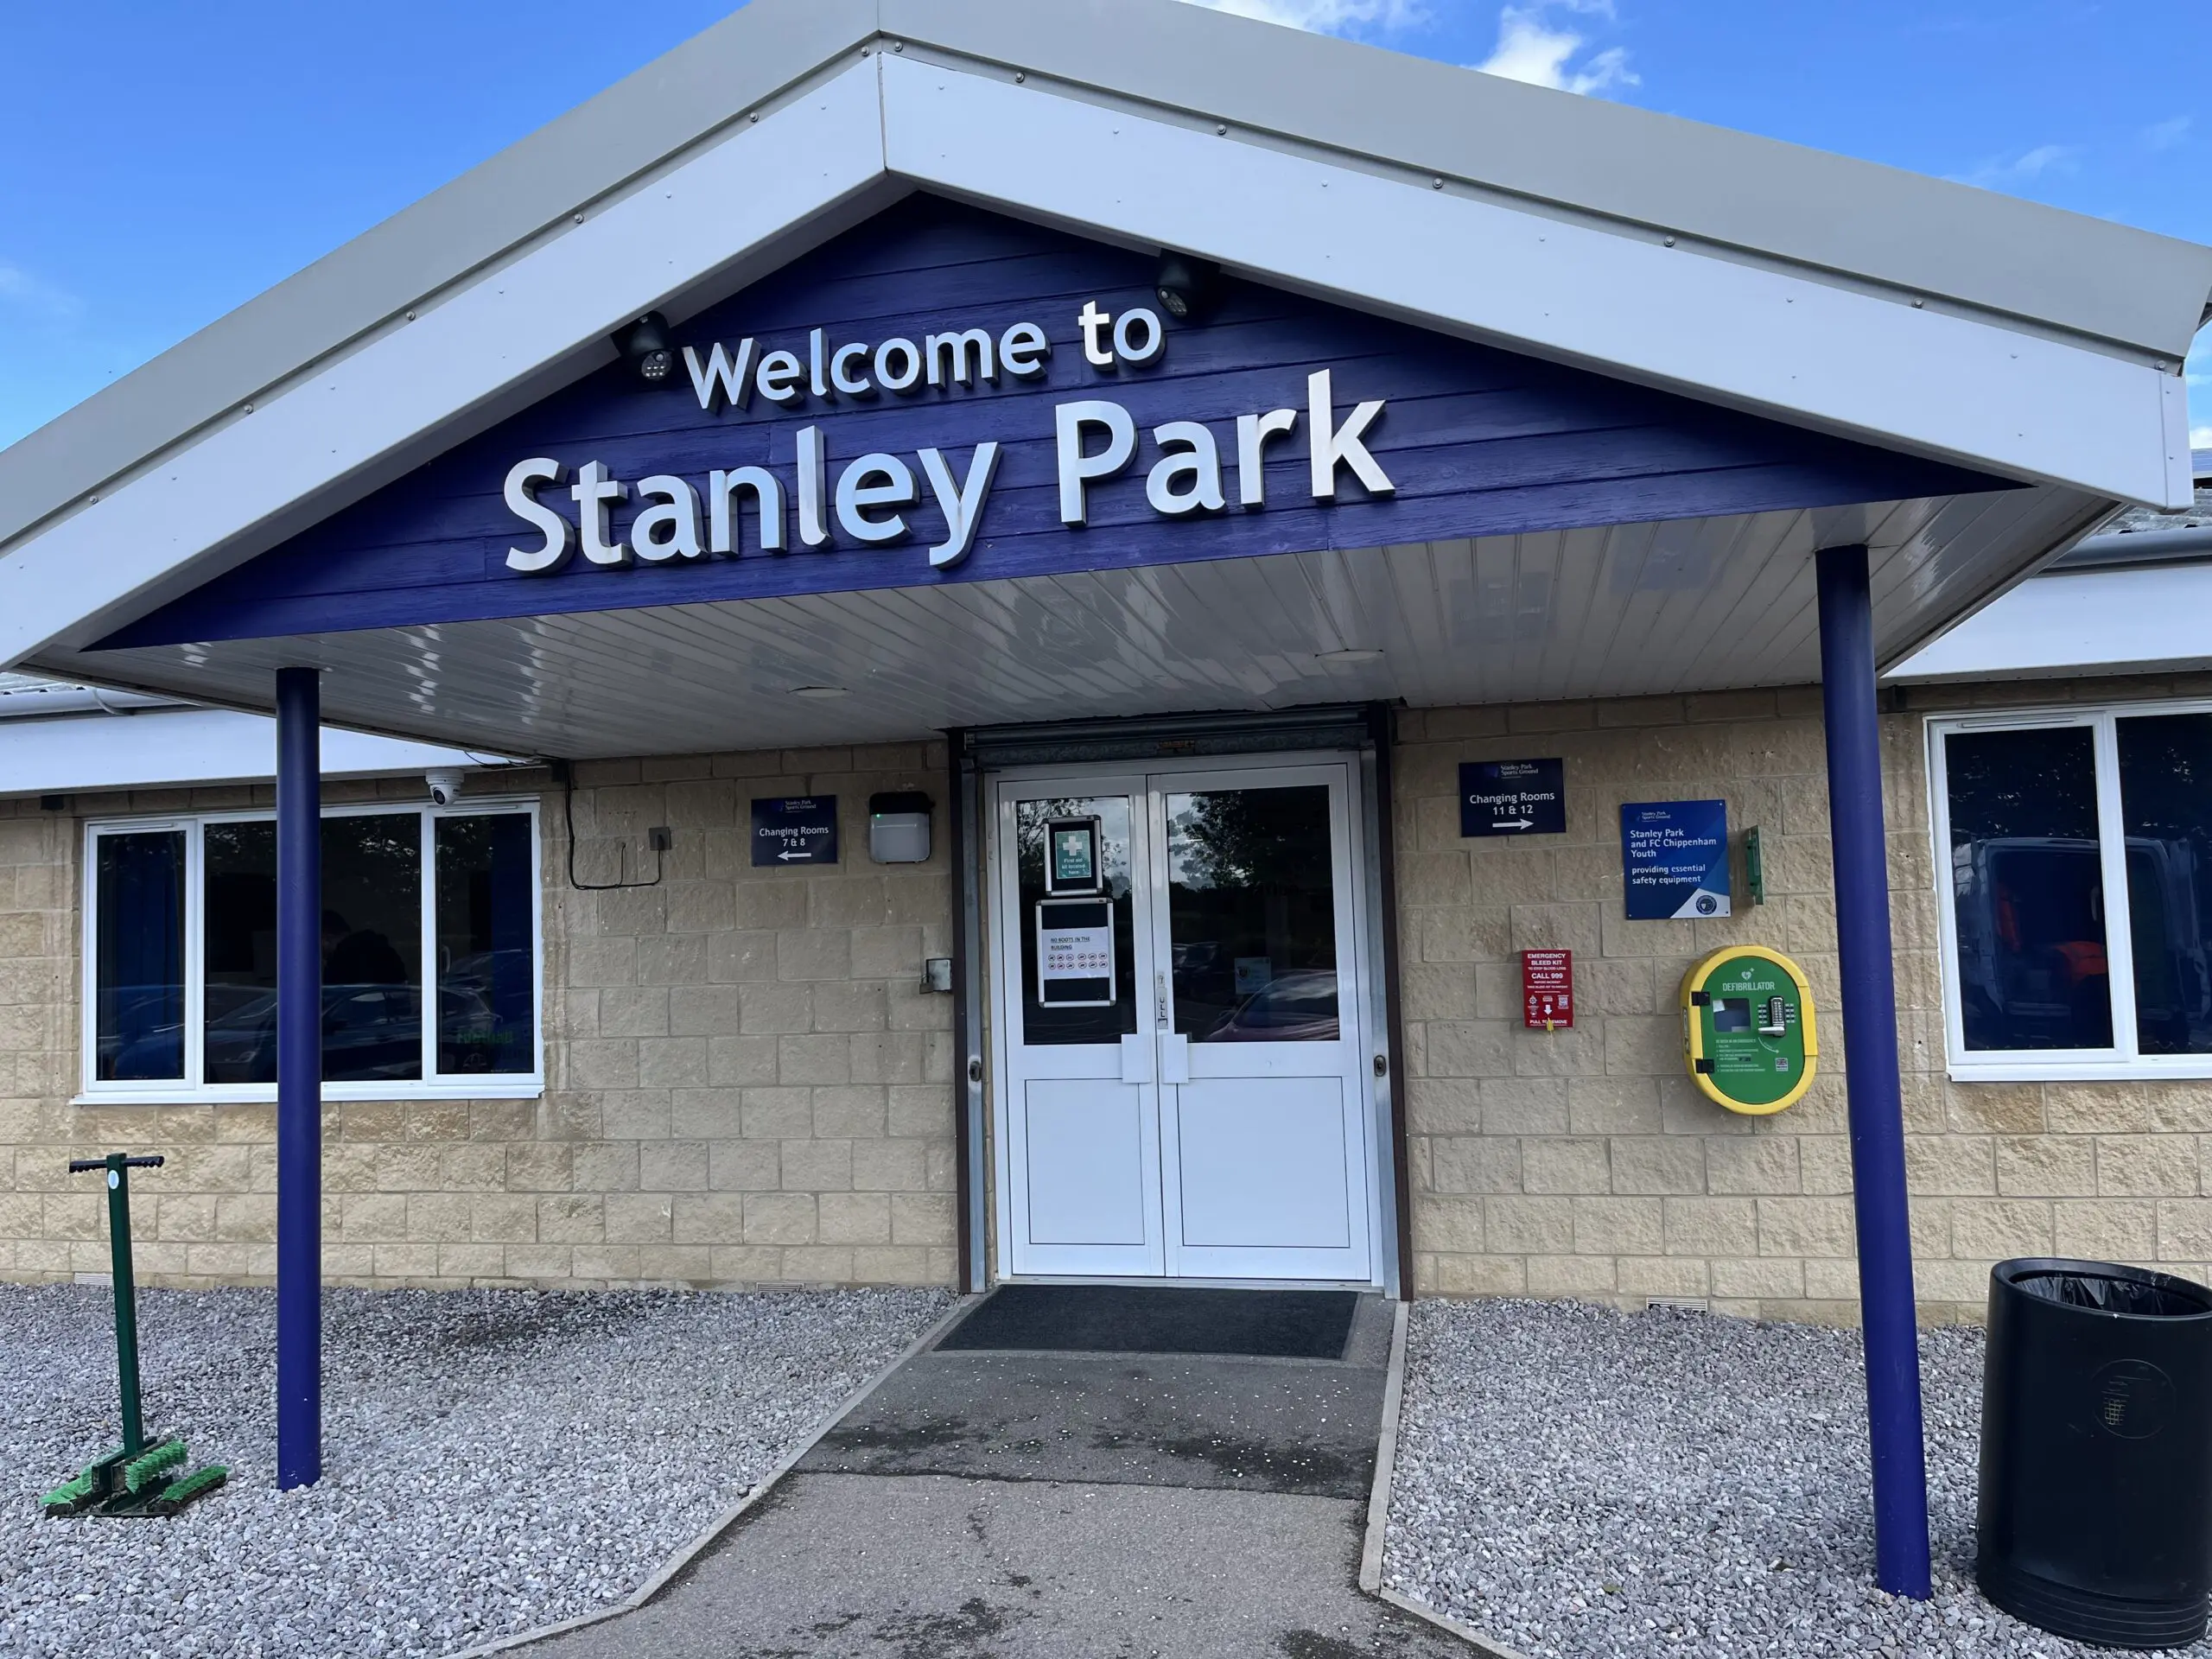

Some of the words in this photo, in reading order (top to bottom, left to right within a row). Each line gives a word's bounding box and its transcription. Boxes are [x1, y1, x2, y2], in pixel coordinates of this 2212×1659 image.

[683, 321, 1052, 412] Welcome
[1078, 301, 1166, 371] to
[505, 425, 1001, 573] Stanley
[1055, 368, 1396, 528] Park
[1470, 793, 1517, 804] Changing
[1521, 792, 1555, 802] Rooms
[1493, 806, 1504, 816] 11
[1509, 805, 1517, 815] &
[1521, 804, 1534, 814] 12
[760, 827, 798, 837] Changing
[801, 826, 830, 836] Rooms
[1630, 829, 1662, 840] Stanley
[1665, 829, 1684, 837] Park
[791, 838, 798, 847] &
[800, 838, 805, 847] 8
[1631, 839, 1646, 849] and
[1649, 839, 1661, 848] FC
[1663, 837, 1717, 849] Chippenham
[1631, 849, 1656, 858] Youth
[1632, 866, 1669, 876] providing
[1671, 864, 1706, 873] essential
[1632, 876, 1656, 886] safety
[1659, 875, 1701, 885] equipment
[1722, 982, 1775, 992] DEFIBRILLATOR
